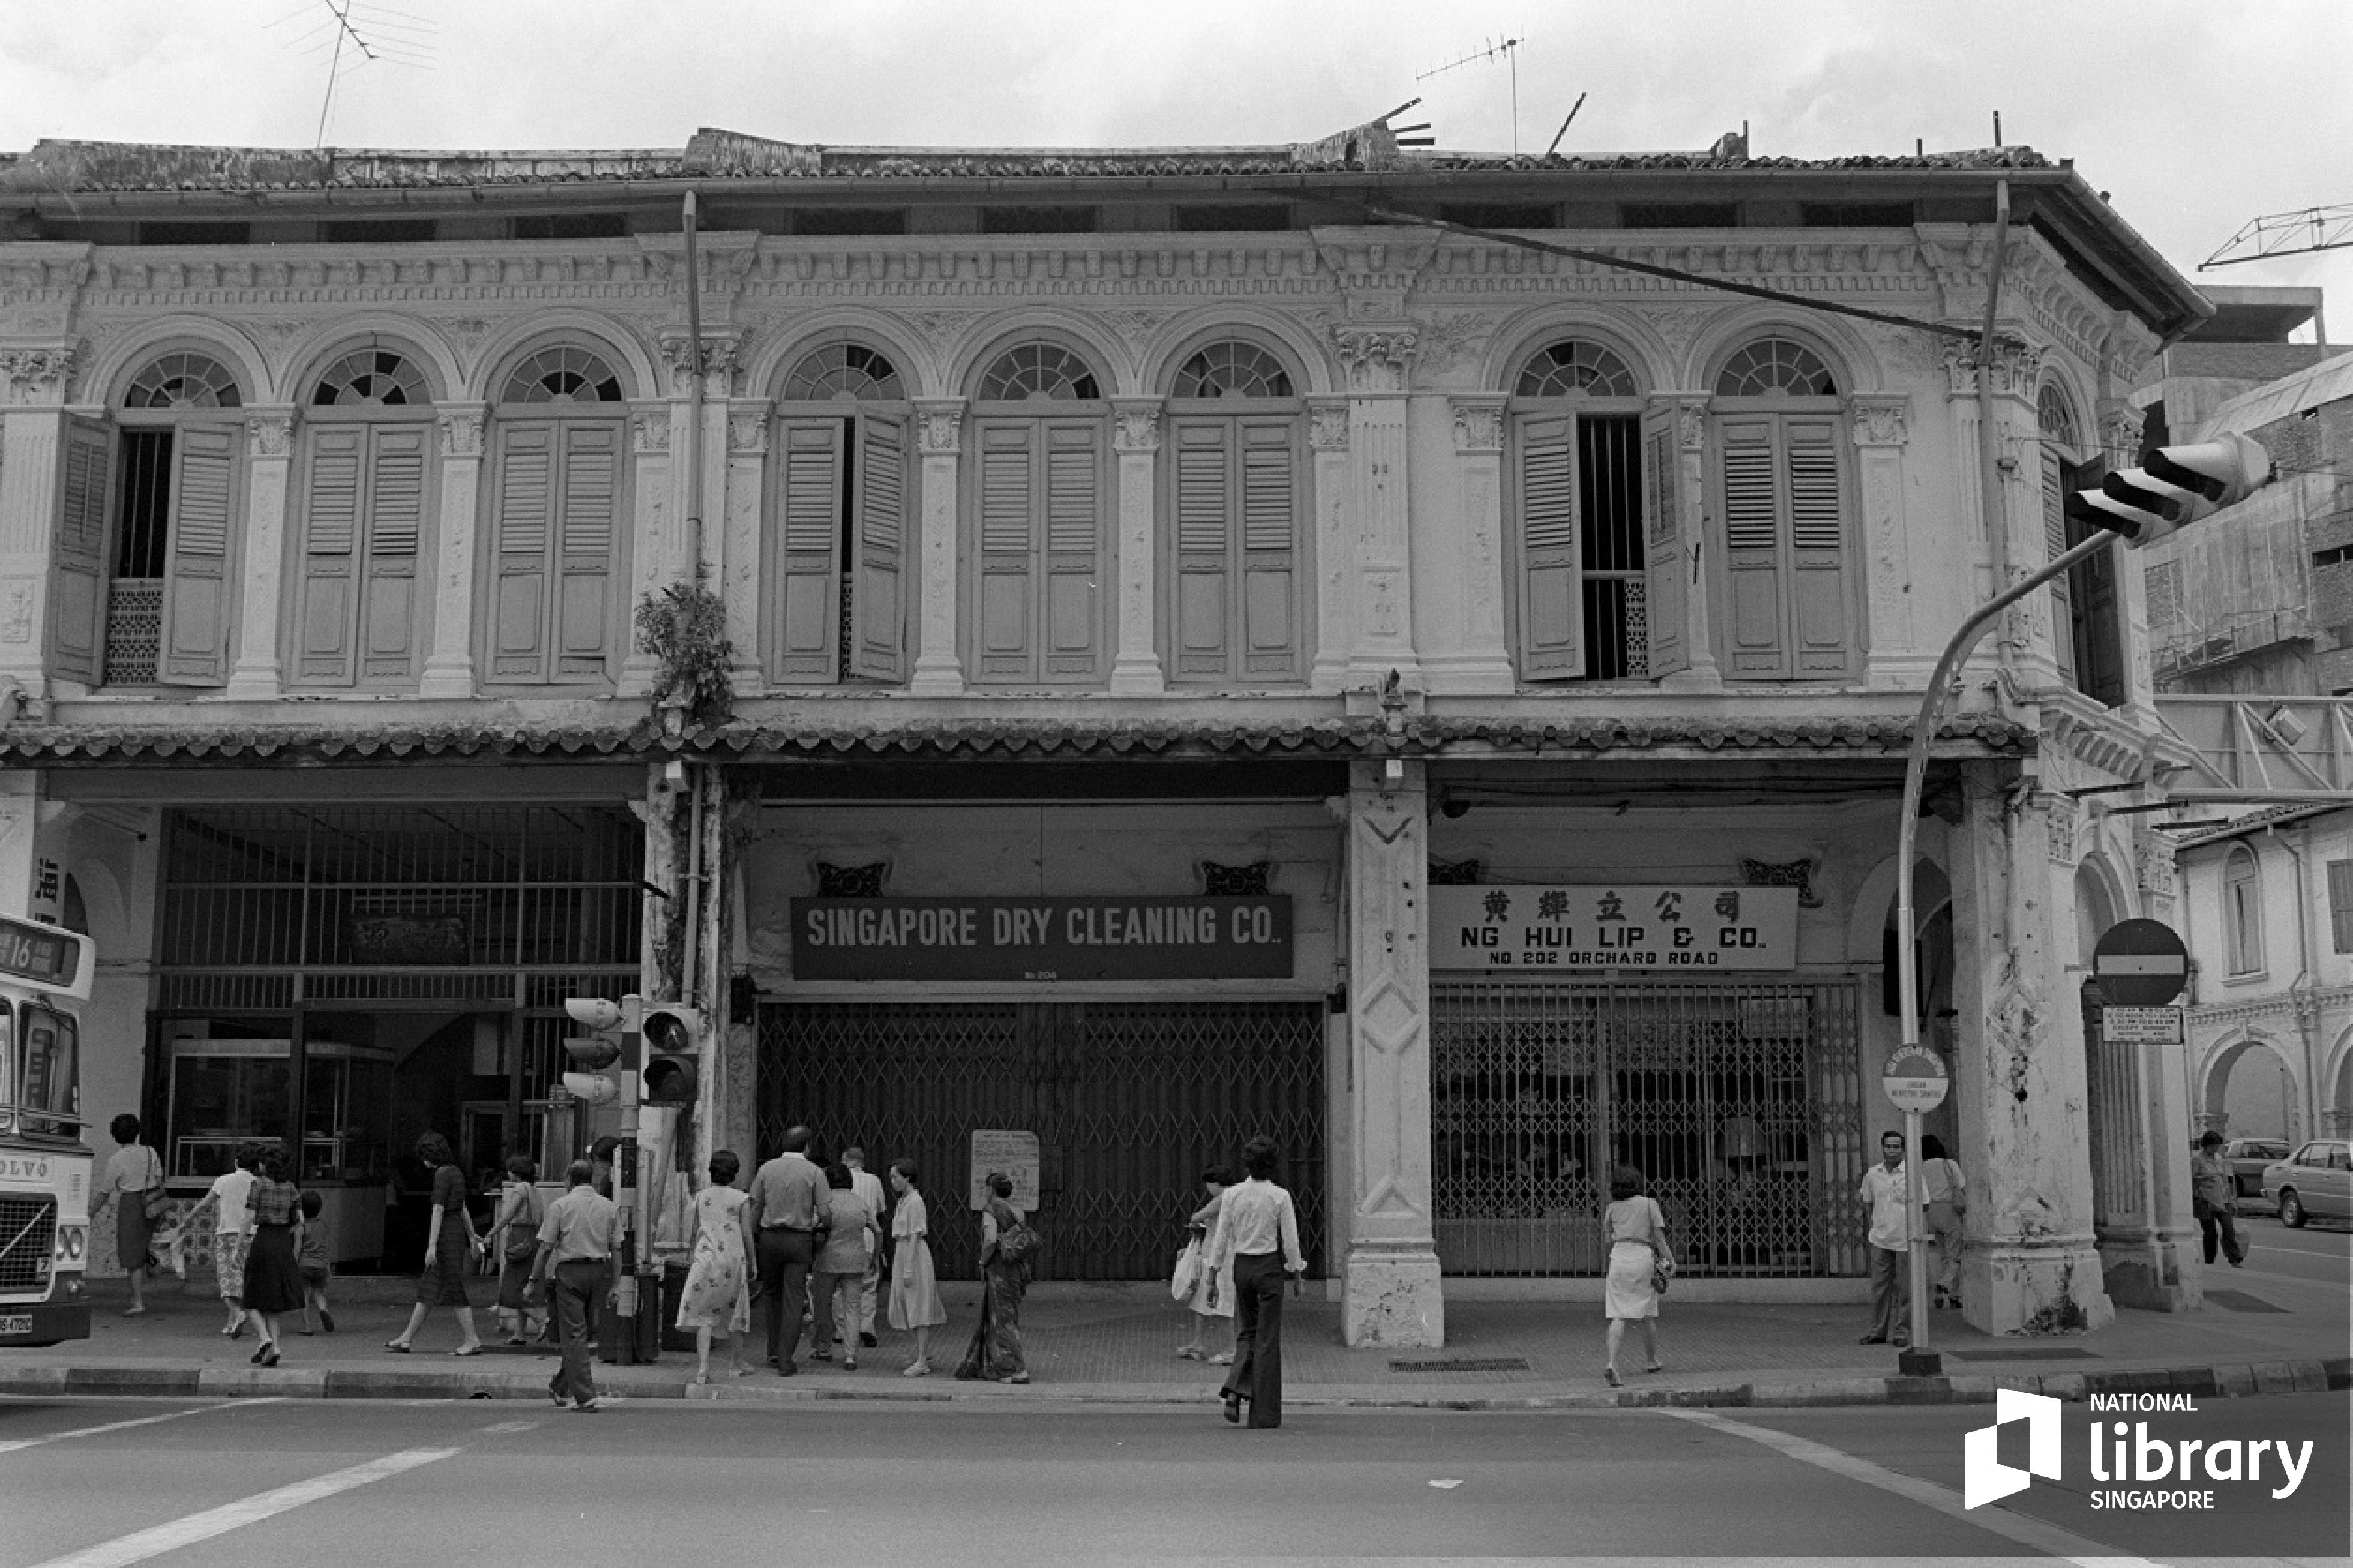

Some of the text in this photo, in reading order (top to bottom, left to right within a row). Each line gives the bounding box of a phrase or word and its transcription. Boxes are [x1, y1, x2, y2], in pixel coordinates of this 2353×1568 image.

[808, 909, 976, 946] SINGAPORE
[993, 908, 1051, 945] DRY
[1067, 907, 1215, 945] CLEANING
[1462, 927, 1766, 948] NG HUI LIP & CO.
[11, 936, 31, 968] 16
[1524, 952, 1557, 965] 202
[1569, 952, 1656, 965] ORCHARD
[1668, 952, 1718, 965] ROAD
